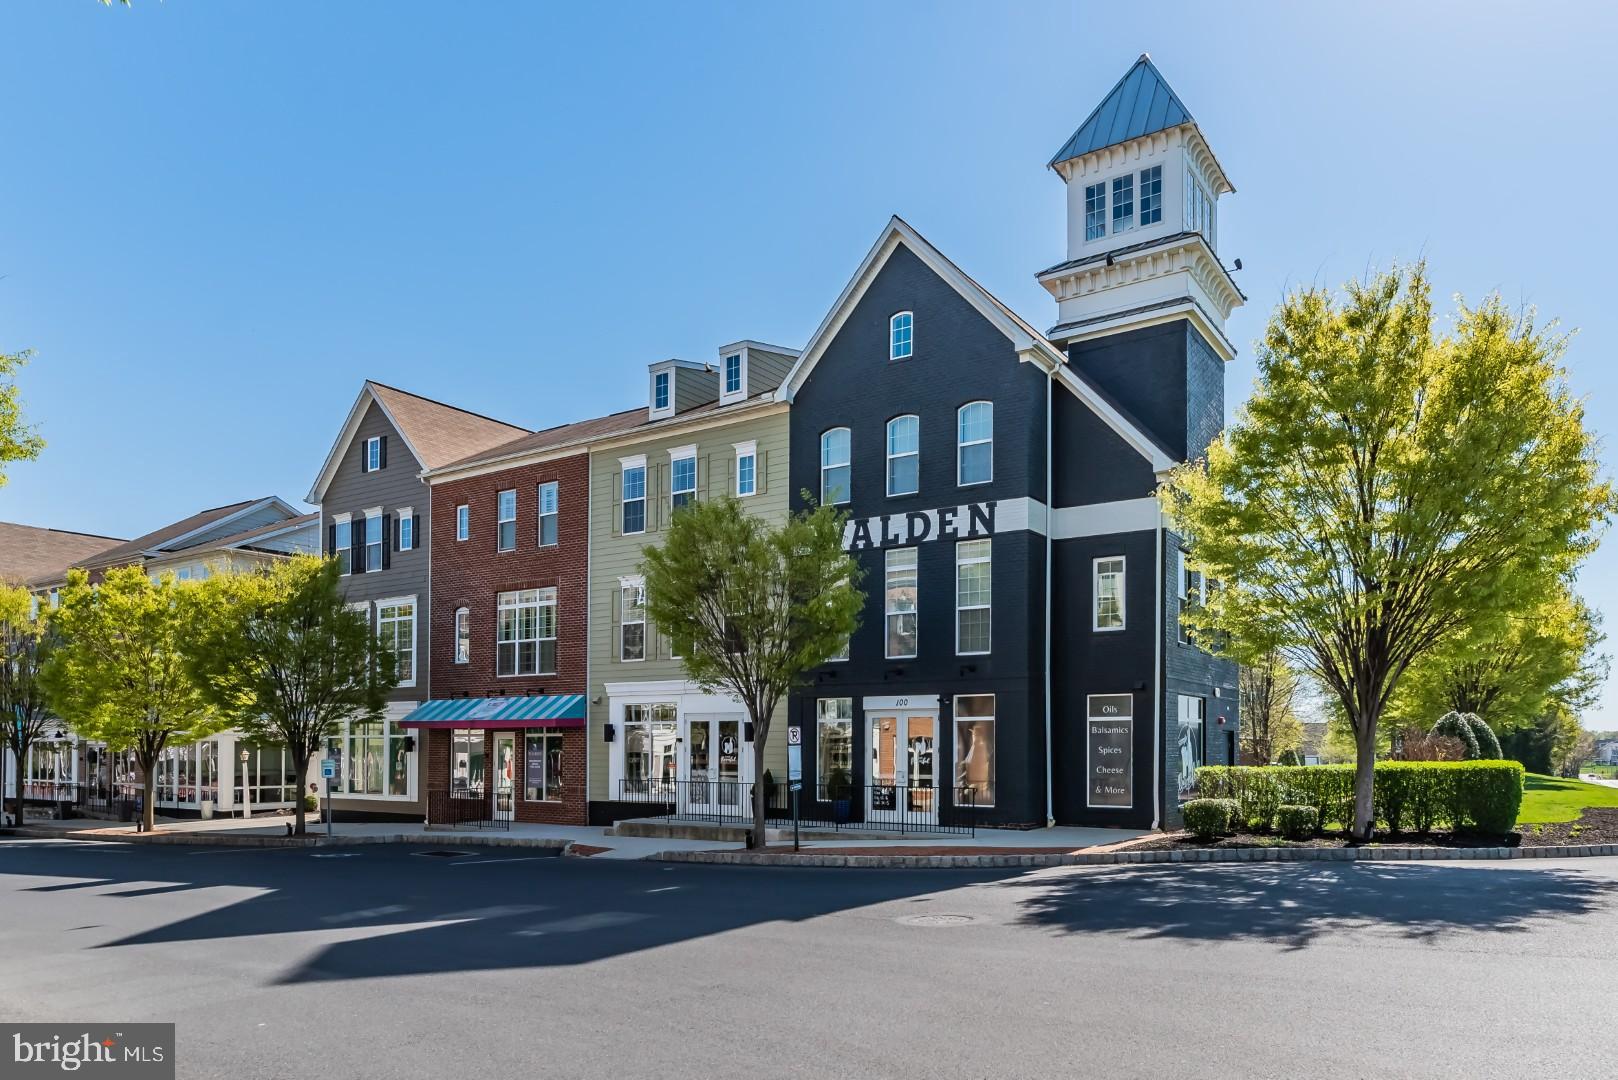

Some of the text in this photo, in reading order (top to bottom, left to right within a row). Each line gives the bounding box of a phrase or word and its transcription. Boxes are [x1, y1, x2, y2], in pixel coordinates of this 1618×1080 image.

[841, 502, 998, 549] ALDEN
[895, 698, 909, 707] 100
[1102, 705, 1118, 714] Oils
[1091, 726, 1129, 734] Balsamics
[1098, 746, 1122, 755] Spices
[1096, 765, 1124, 774] Cheese
[1095, 786, 1125, 794] & More
